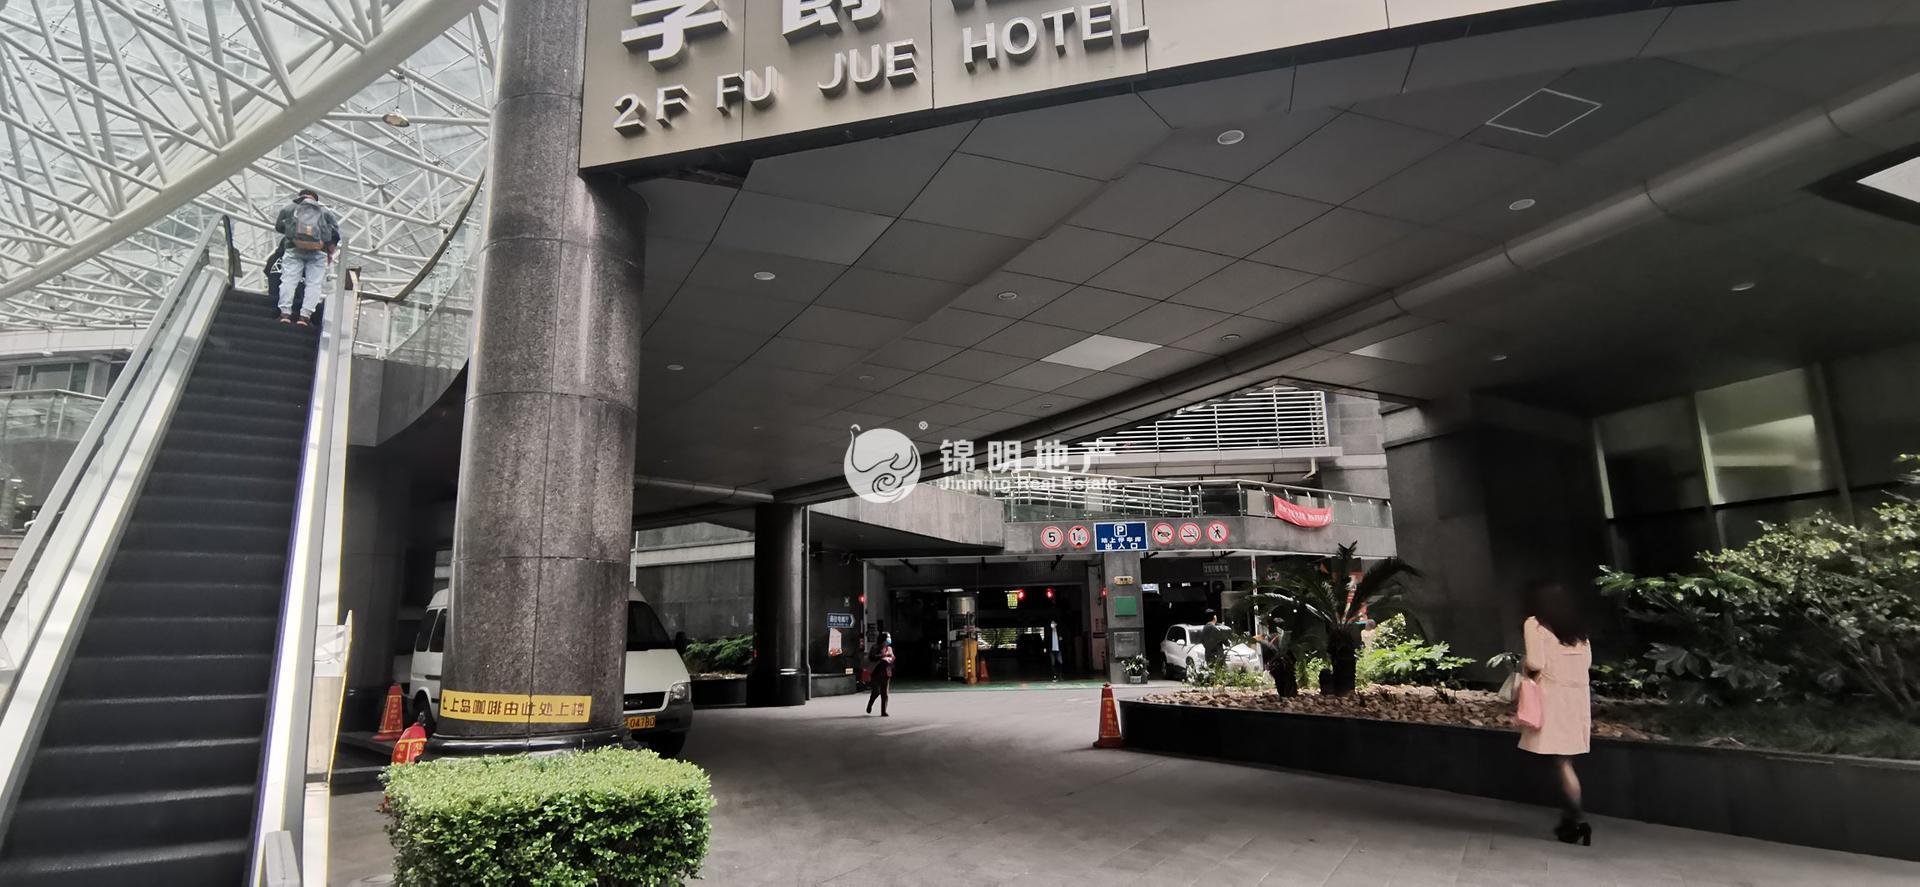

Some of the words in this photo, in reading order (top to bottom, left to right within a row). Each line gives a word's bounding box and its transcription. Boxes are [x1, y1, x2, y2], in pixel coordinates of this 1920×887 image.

[613, 84, 690, 135] 2F
[714, 66, 779, 114] FU
[817, 39, 918, 97] JUE
[963, 0, 1150, 70] HOTEL
[1116, 526, 1125, 536] P
[1048, 532, 1056, 543] 5
